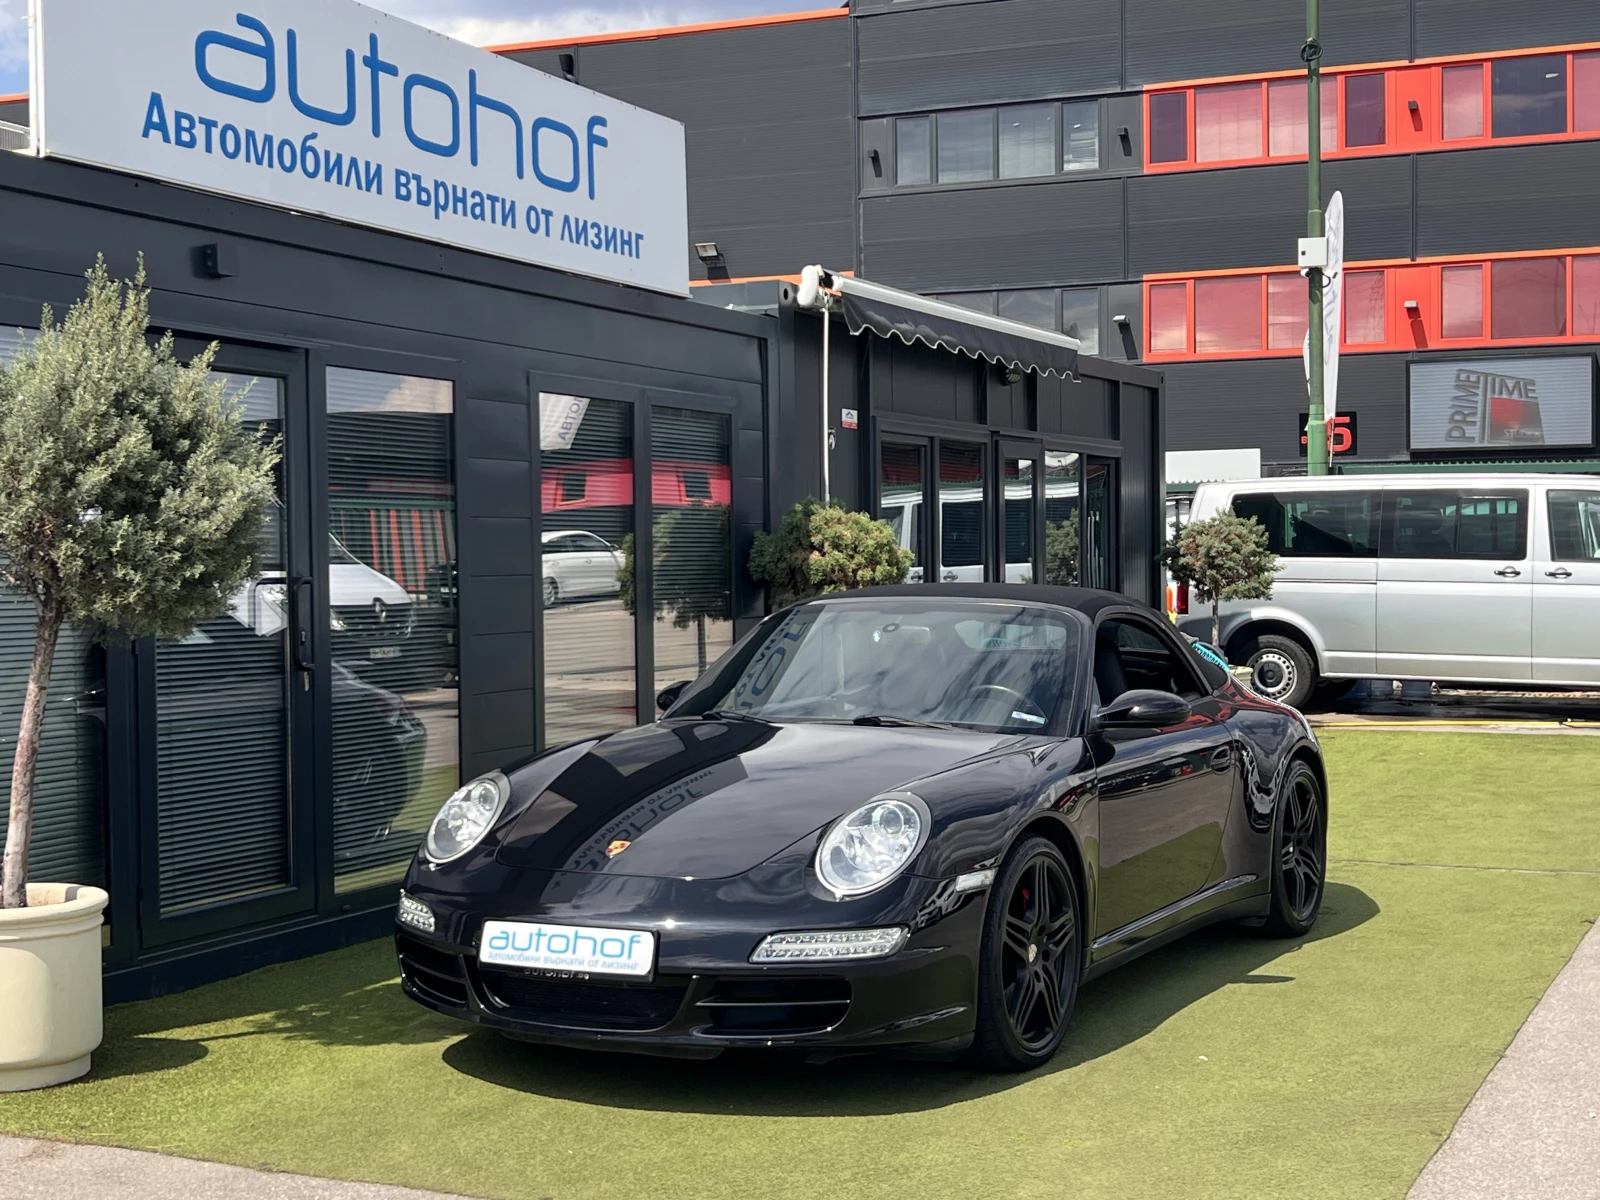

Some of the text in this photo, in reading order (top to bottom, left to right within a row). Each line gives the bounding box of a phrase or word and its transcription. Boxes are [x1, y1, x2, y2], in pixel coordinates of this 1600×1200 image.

[195, 13, 608, 200] autohof
[141, 91, 644, 259] Автомобили върнати от лизинг
[1445, 373, 1480, 442] PRIME
[488, 951, 640, 971] Автомобили върнати от лизинг
[489, 927, 642, 959] autohof
